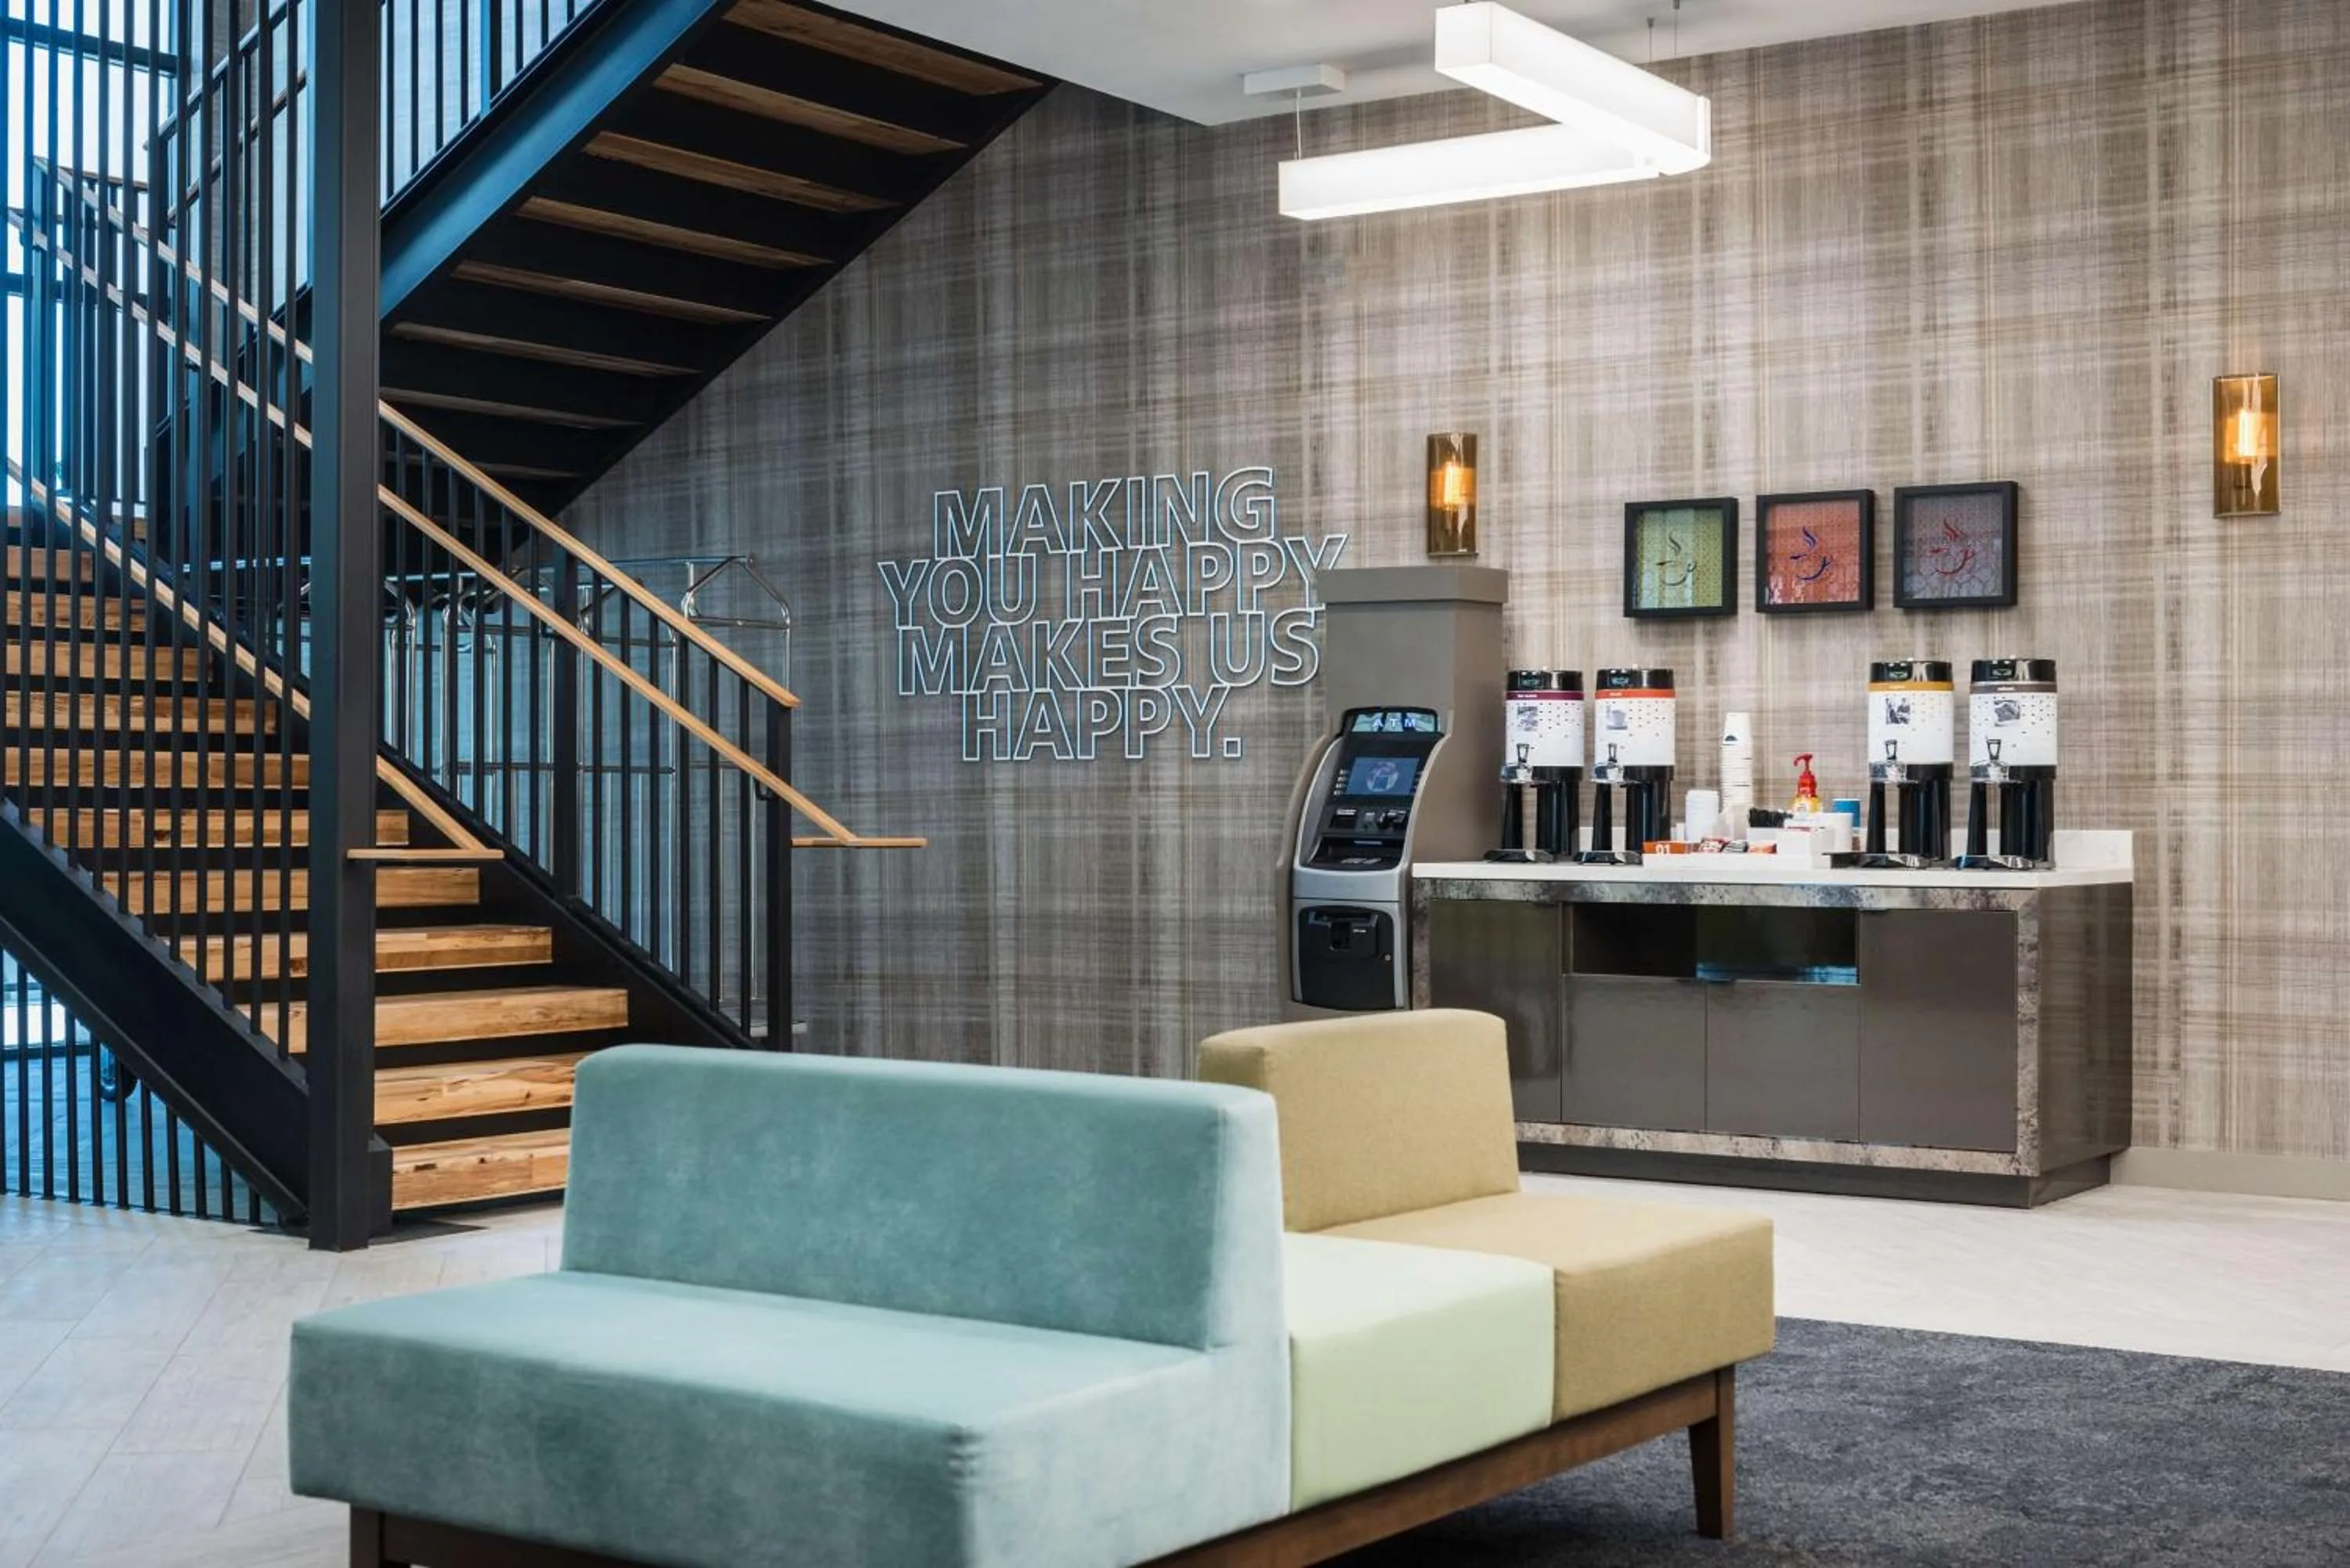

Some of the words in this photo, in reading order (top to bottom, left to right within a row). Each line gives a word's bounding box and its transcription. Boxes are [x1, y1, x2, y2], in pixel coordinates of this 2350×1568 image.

[934, 466, 1275, 559] MAKING
[877, 553, 1038, 628] YOU
[1066, 533, 1349, 621] HAPPY
[898, 614, 1182, 695] MAKES
[1209, 608, 1320, 687] US
[962, 685, 1243, 761] HAPPY.
[1372, 718, 1416, 728] ATM
